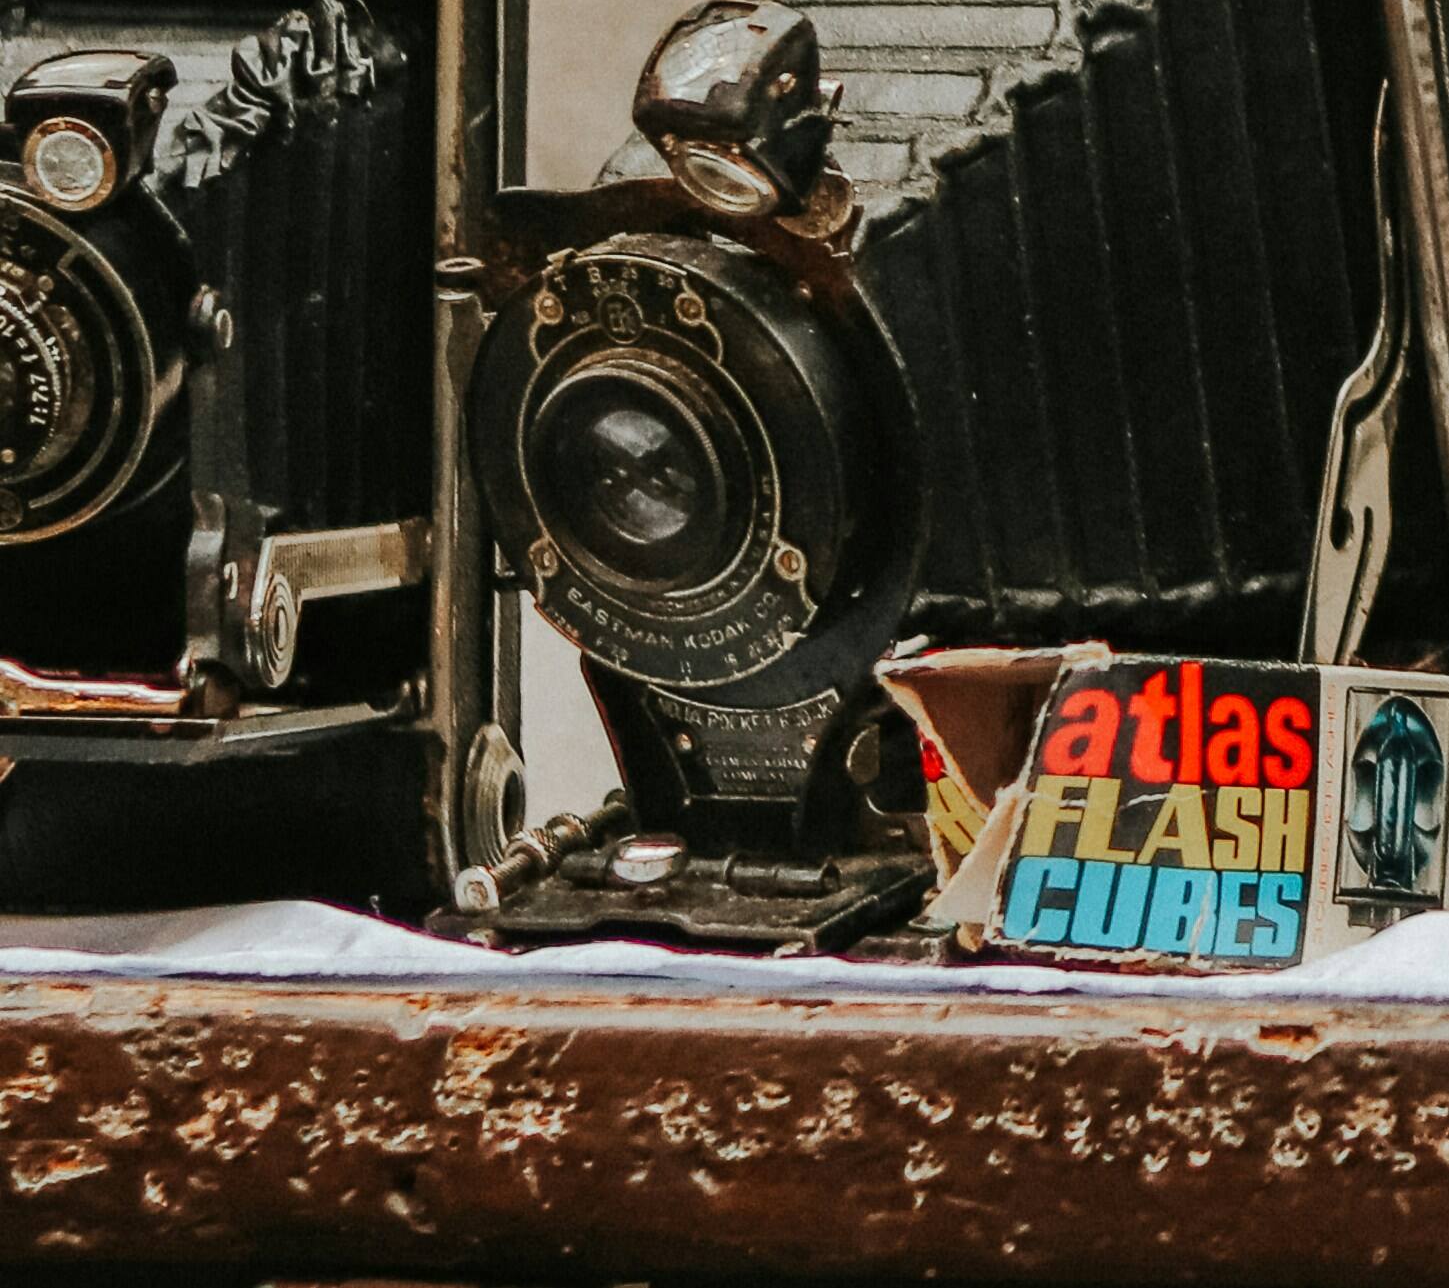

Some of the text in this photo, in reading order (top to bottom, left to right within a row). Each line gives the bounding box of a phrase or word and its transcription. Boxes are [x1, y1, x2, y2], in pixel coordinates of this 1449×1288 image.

[566, 586, 674, 650] EASTMAN
[683, 619, 752, 650] KODAK
[1041, 661, 1314, 787] atlas
[1020, 773, 1311, 873] FLASH
[1003, 856, 1306, 958] CUBES
